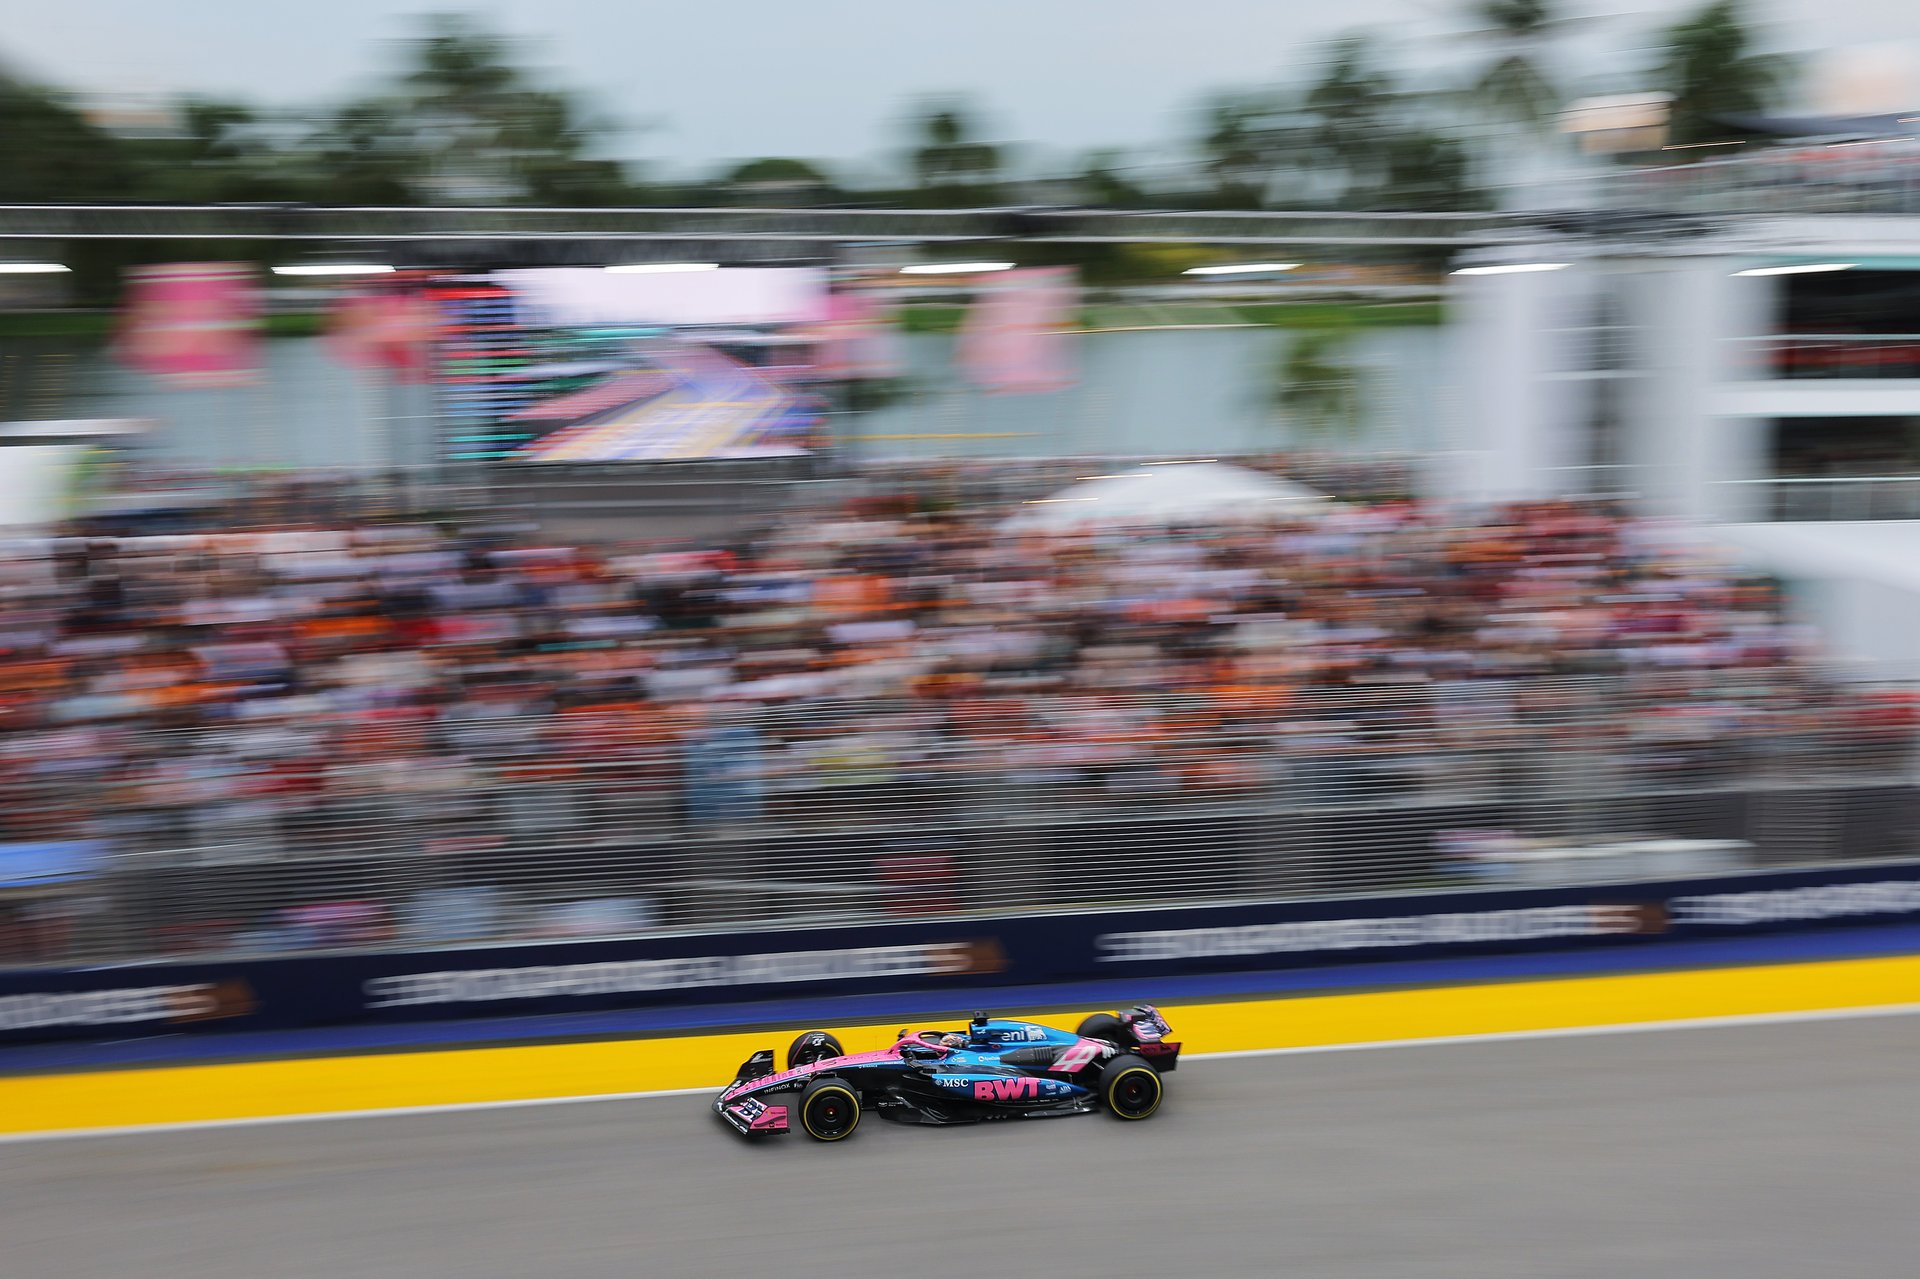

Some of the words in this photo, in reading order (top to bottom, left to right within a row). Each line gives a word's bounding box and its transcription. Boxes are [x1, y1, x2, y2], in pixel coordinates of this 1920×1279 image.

[1001, 1028, 1025, 1041] eni
[943, 1078, 969, 1088] MSC
[974, 1077, 1041, 1101] BWT
